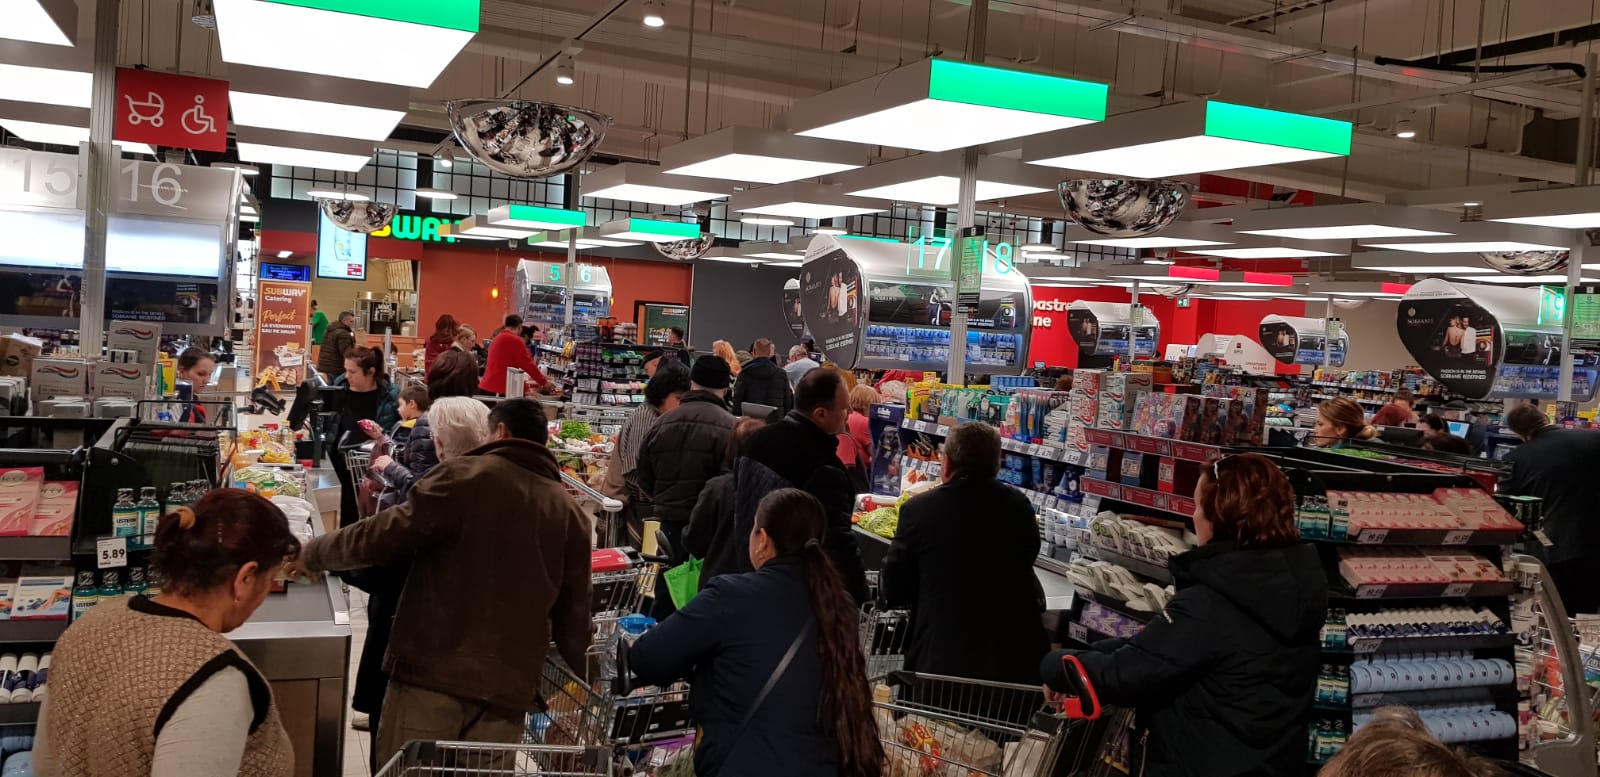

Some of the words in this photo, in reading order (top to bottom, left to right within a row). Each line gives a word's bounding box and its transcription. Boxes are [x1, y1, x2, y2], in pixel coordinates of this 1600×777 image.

[121, 162, 183, 206] 16
[913, 235, 952, 270] 17
[980, 240, 1013, 275] 18
[550, 264, 561, 282] 5
[580, 264, 592, 282] 6
[264, 287, 306, 297] SUBWAY
[264, 295, 292, 304] Catering
[262, 309, 296, 322] Perfect
[1544, 292, 1566, 321] 19
[102, 548, 125, 560] 5.89
